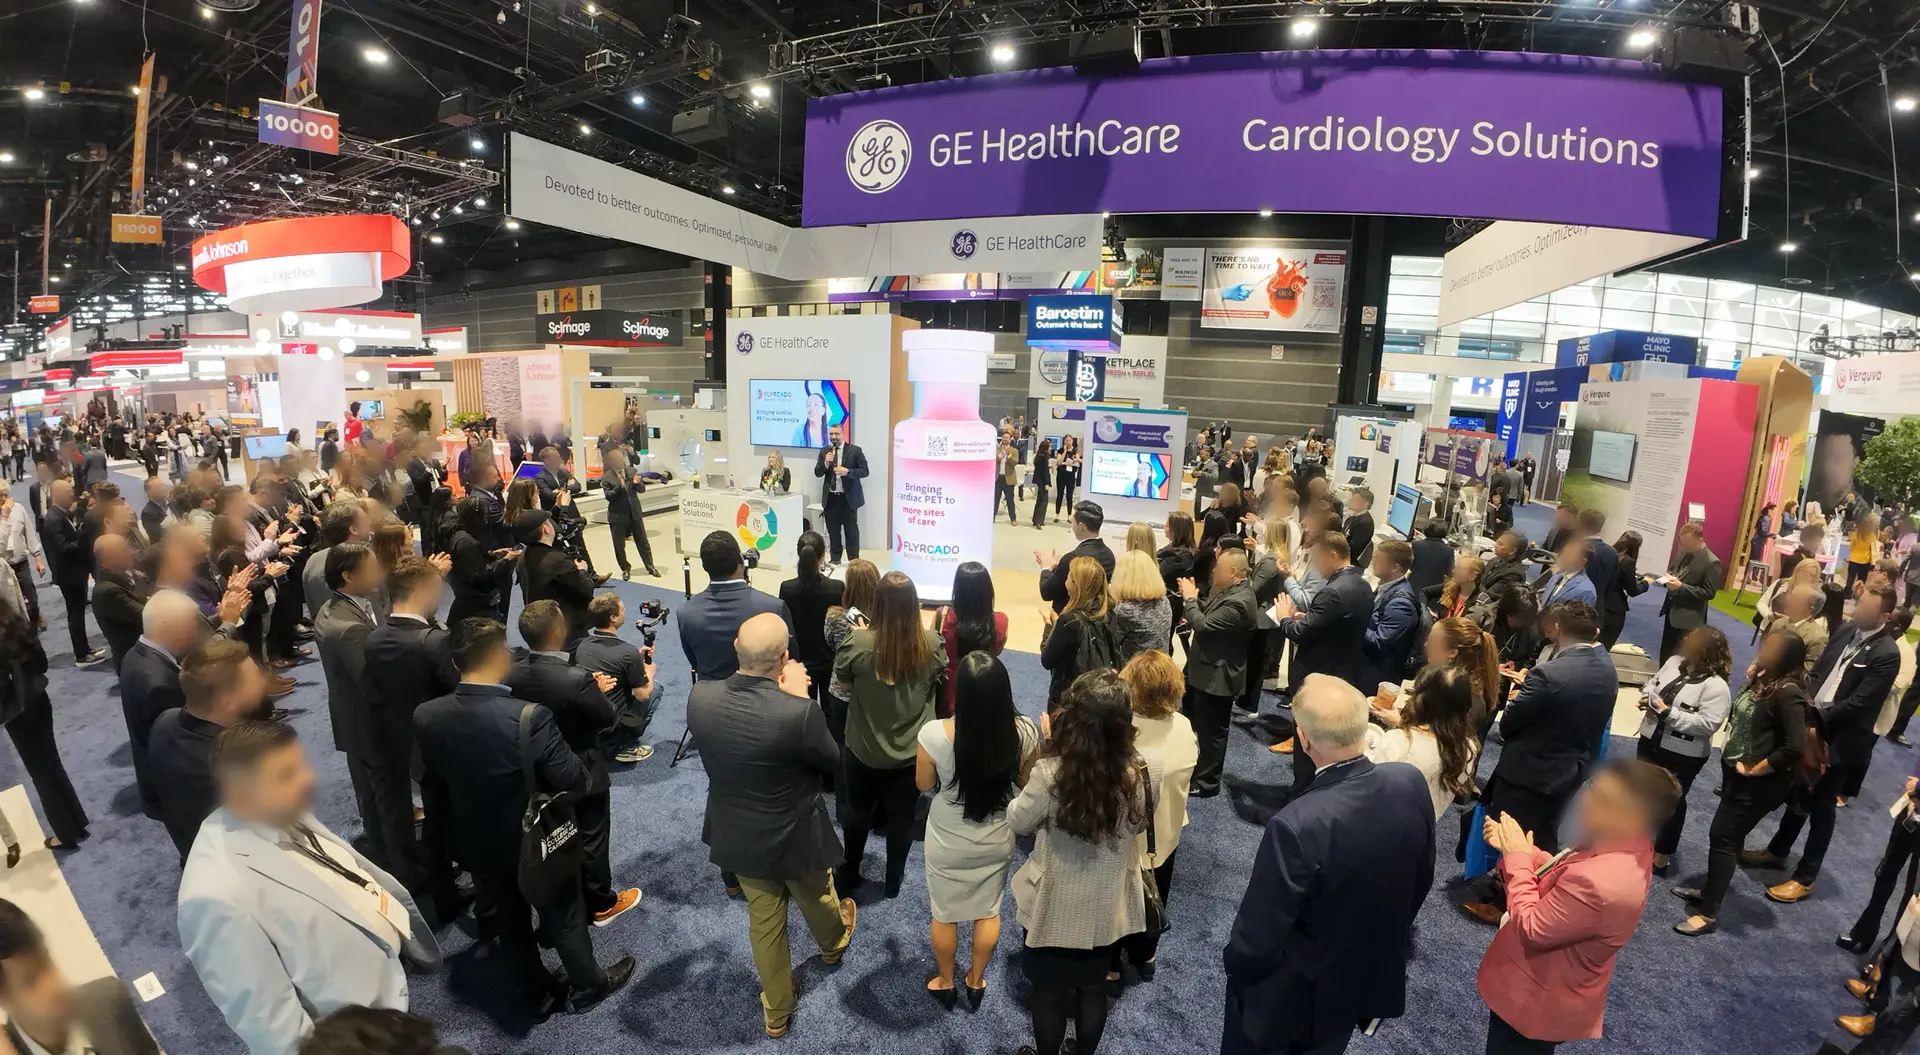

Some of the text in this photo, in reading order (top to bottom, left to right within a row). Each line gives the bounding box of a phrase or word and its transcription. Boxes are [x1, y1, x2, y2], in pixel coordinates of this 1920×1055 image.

[265, 113, 334, 140] 10000
[930, 120, 1181, 167] GE HealthCare
[1243, 115, 1660, 170] Cardiology Solutions
[545, 175, 595, 202] Devoted
[597, 193, 609, 205] to
[611, 193, 642, 215] better
[643, 205, 690, 229] outcomes.
[692, 218, 735, 244] Optimized,
[735, 232, 764, 251] personal
[117, 223, 157, 236] 11000
[986, 234, 1087, 251] GE HealthCare
[1211, 255, 1246, 263] THERE'S
[1215, 262, 1237, 270] TIME
[1450, 271, 1471, 292] Devoted
[1478, 261, 1496, 280] better
[1036, 306, 1104, 321] Barostim
[1035, 322, 1104, 330] Outsmart the heart
[760, 336, 829, 349] GE HealthCare
[1646, 336, 1671, 345] MAYO
[1643, 344, 1672, 354] CLINIC
[1105, 357, 1156, 368] KETPLACE
[1105, 368, 1127, 377] FRESH
[1848, 368, 1883, 385] Verquvo
[1589, 390, 1611, 400] Verquvo
[905, 482, 943, 496] Bringing
[682, 498, 718, 511] Cardiology
[924, 495, 943, 504] PET
[945, 496, 956, 505] to
[682, 508, 715, 519] Solutions
[902, 506, 946, 518] more sites
[907, 515, 937, 527] of care
[903, 541, 960, 555] FLYRCADO
[546, 820, 572, 841] AMERICAN
[547, 828, 569, 847] COLLEGE
[547, 827, 579, 854] CARDIOLOGY
